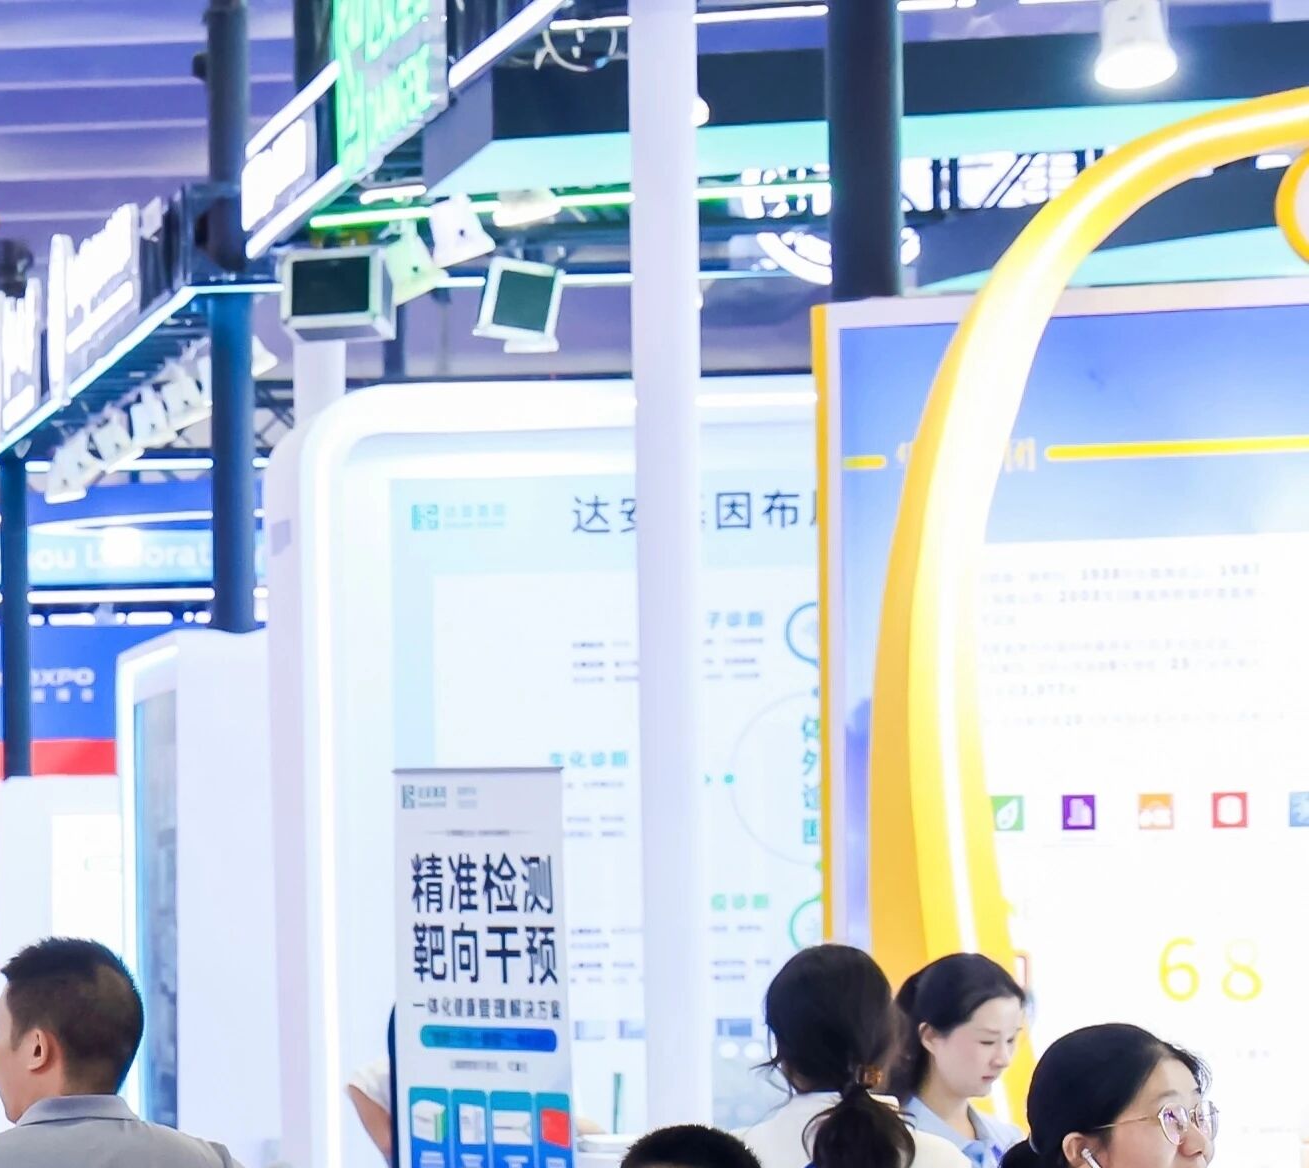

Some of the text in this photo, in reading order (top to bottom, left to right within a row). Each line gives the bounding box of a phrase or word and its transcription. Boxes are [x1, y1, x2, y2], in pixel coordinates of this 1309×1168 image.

[571, 488, 818, 534] 达因布
[410, 853, 554, 915] 精准检测
[412, 922, 559, 985] 靶向干预
